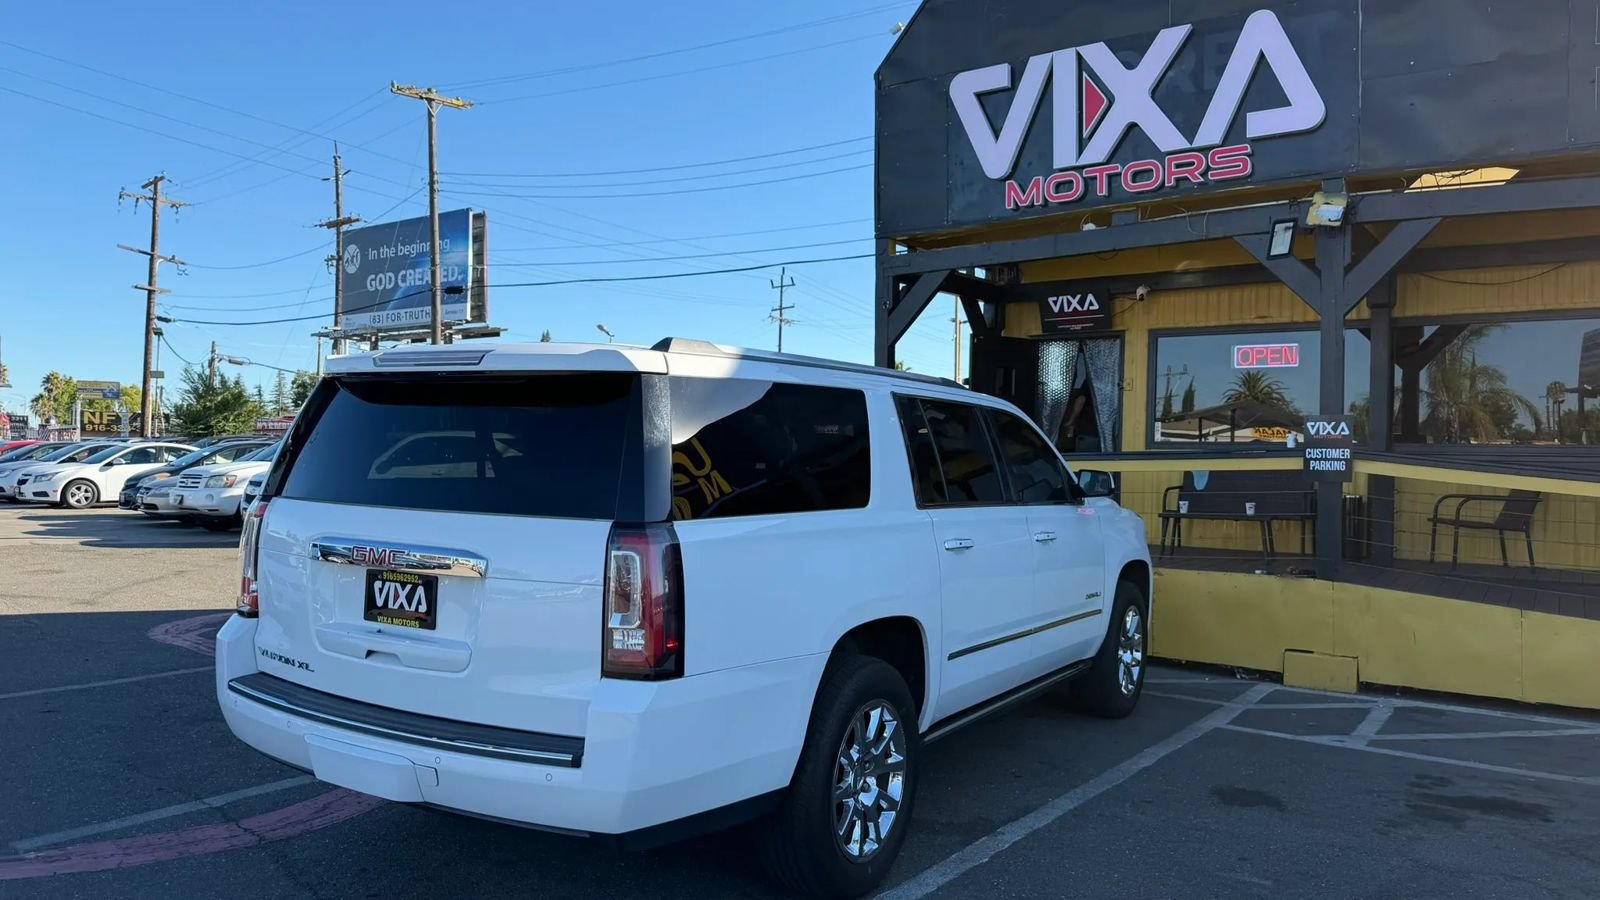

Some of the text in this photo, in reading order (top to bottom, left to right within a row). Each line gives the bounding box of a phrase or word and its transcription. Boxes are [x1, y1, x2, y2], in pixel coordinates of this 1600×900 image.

[949, 9, 1327, 180] VIXA
[1005, 143, 1253, 209] MOTORS
[368, 248, 378, 260] In
[379, 245, 396, 258] the
[366, 272, 395, 291] GOD
[1047, 293, 1100, 313] VIXA
[369, 312, 384, 325] (83)
[386, 309, 431, 323] FOR-TRUTH
[1238, 346, 1297, 366] OPEN
[1306, 421, 1350, 436] VIXA
[1305, 448, 1351, 459] CUSTOMER
[1310, 460, 1346, 471] PARKING
[352, 545, 407, 567] GMC
[373, 580, 428, 613] VIXA
[377, 615, 420, 628] VIXA MOTORS
